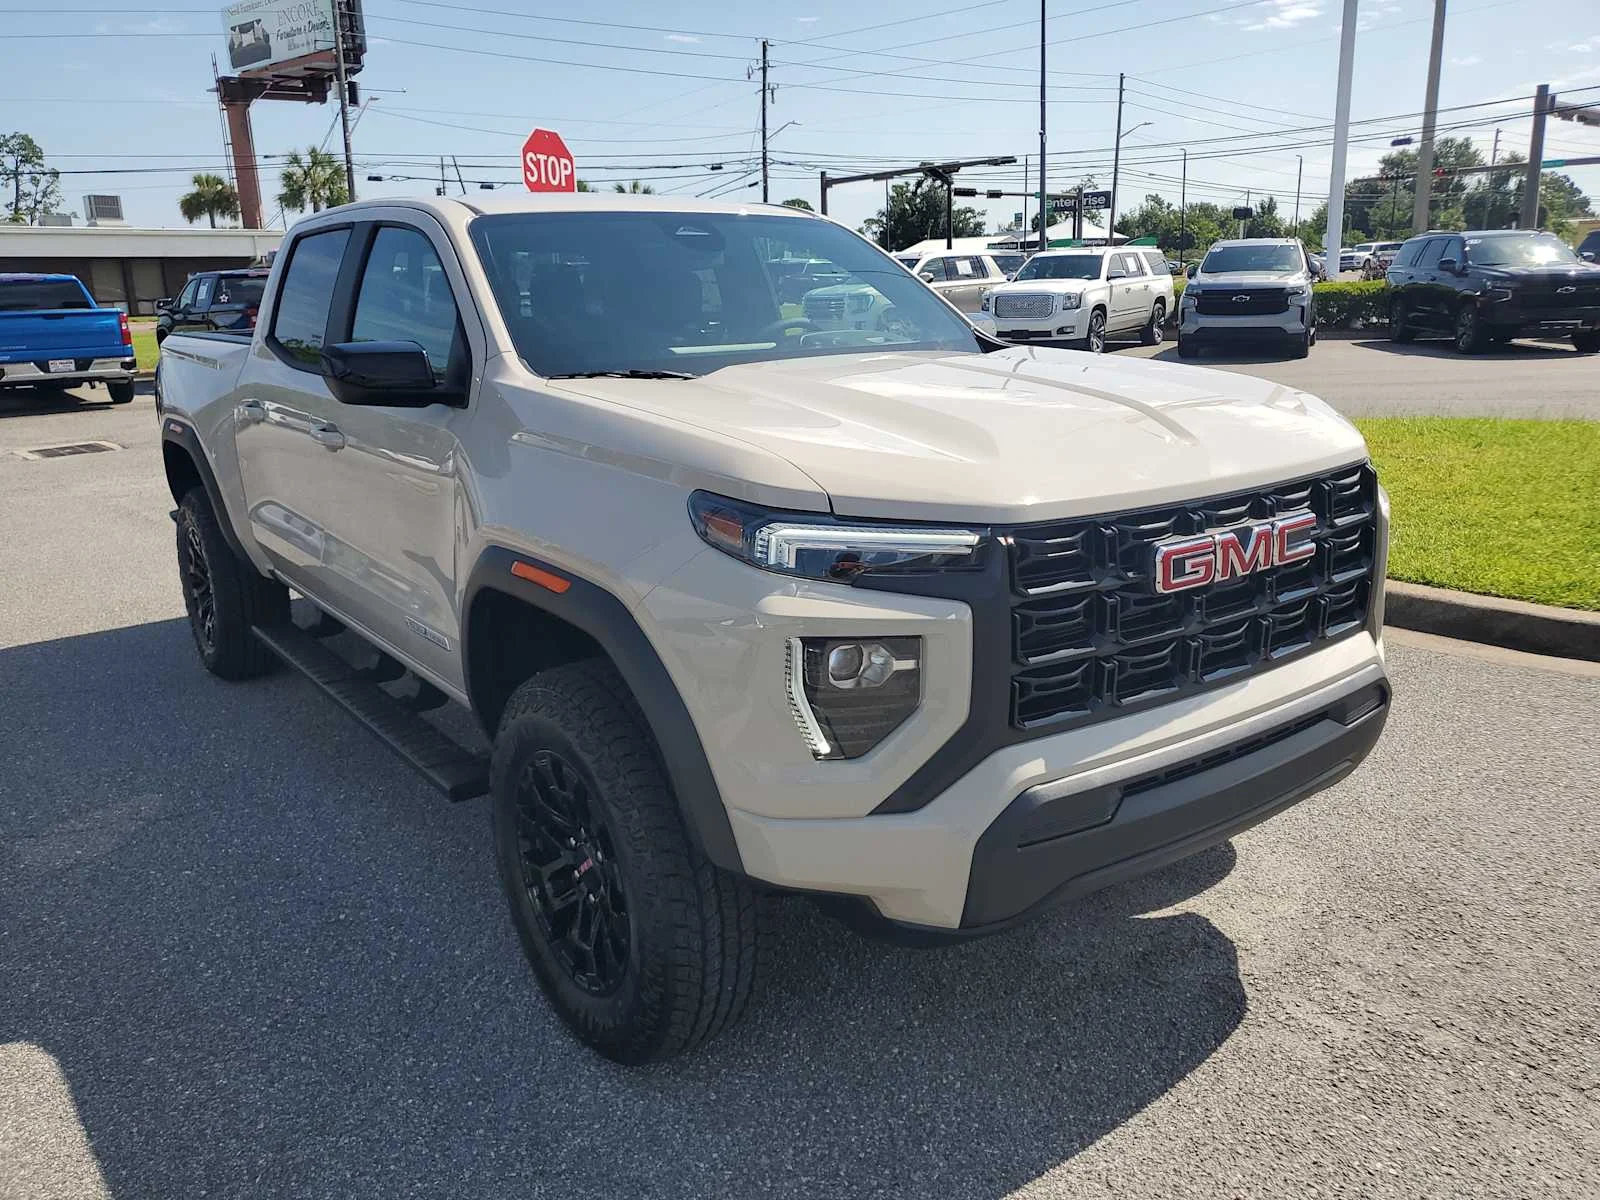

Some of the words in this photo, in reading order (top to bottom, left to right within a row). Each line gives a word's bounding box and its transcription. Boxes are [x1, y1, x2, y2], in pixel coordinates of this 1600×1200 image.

[279, 1, 319, 26] ENCORE
[526, 152, 572, 187] STOP
[1155, 511, 1317, 594] GMC
